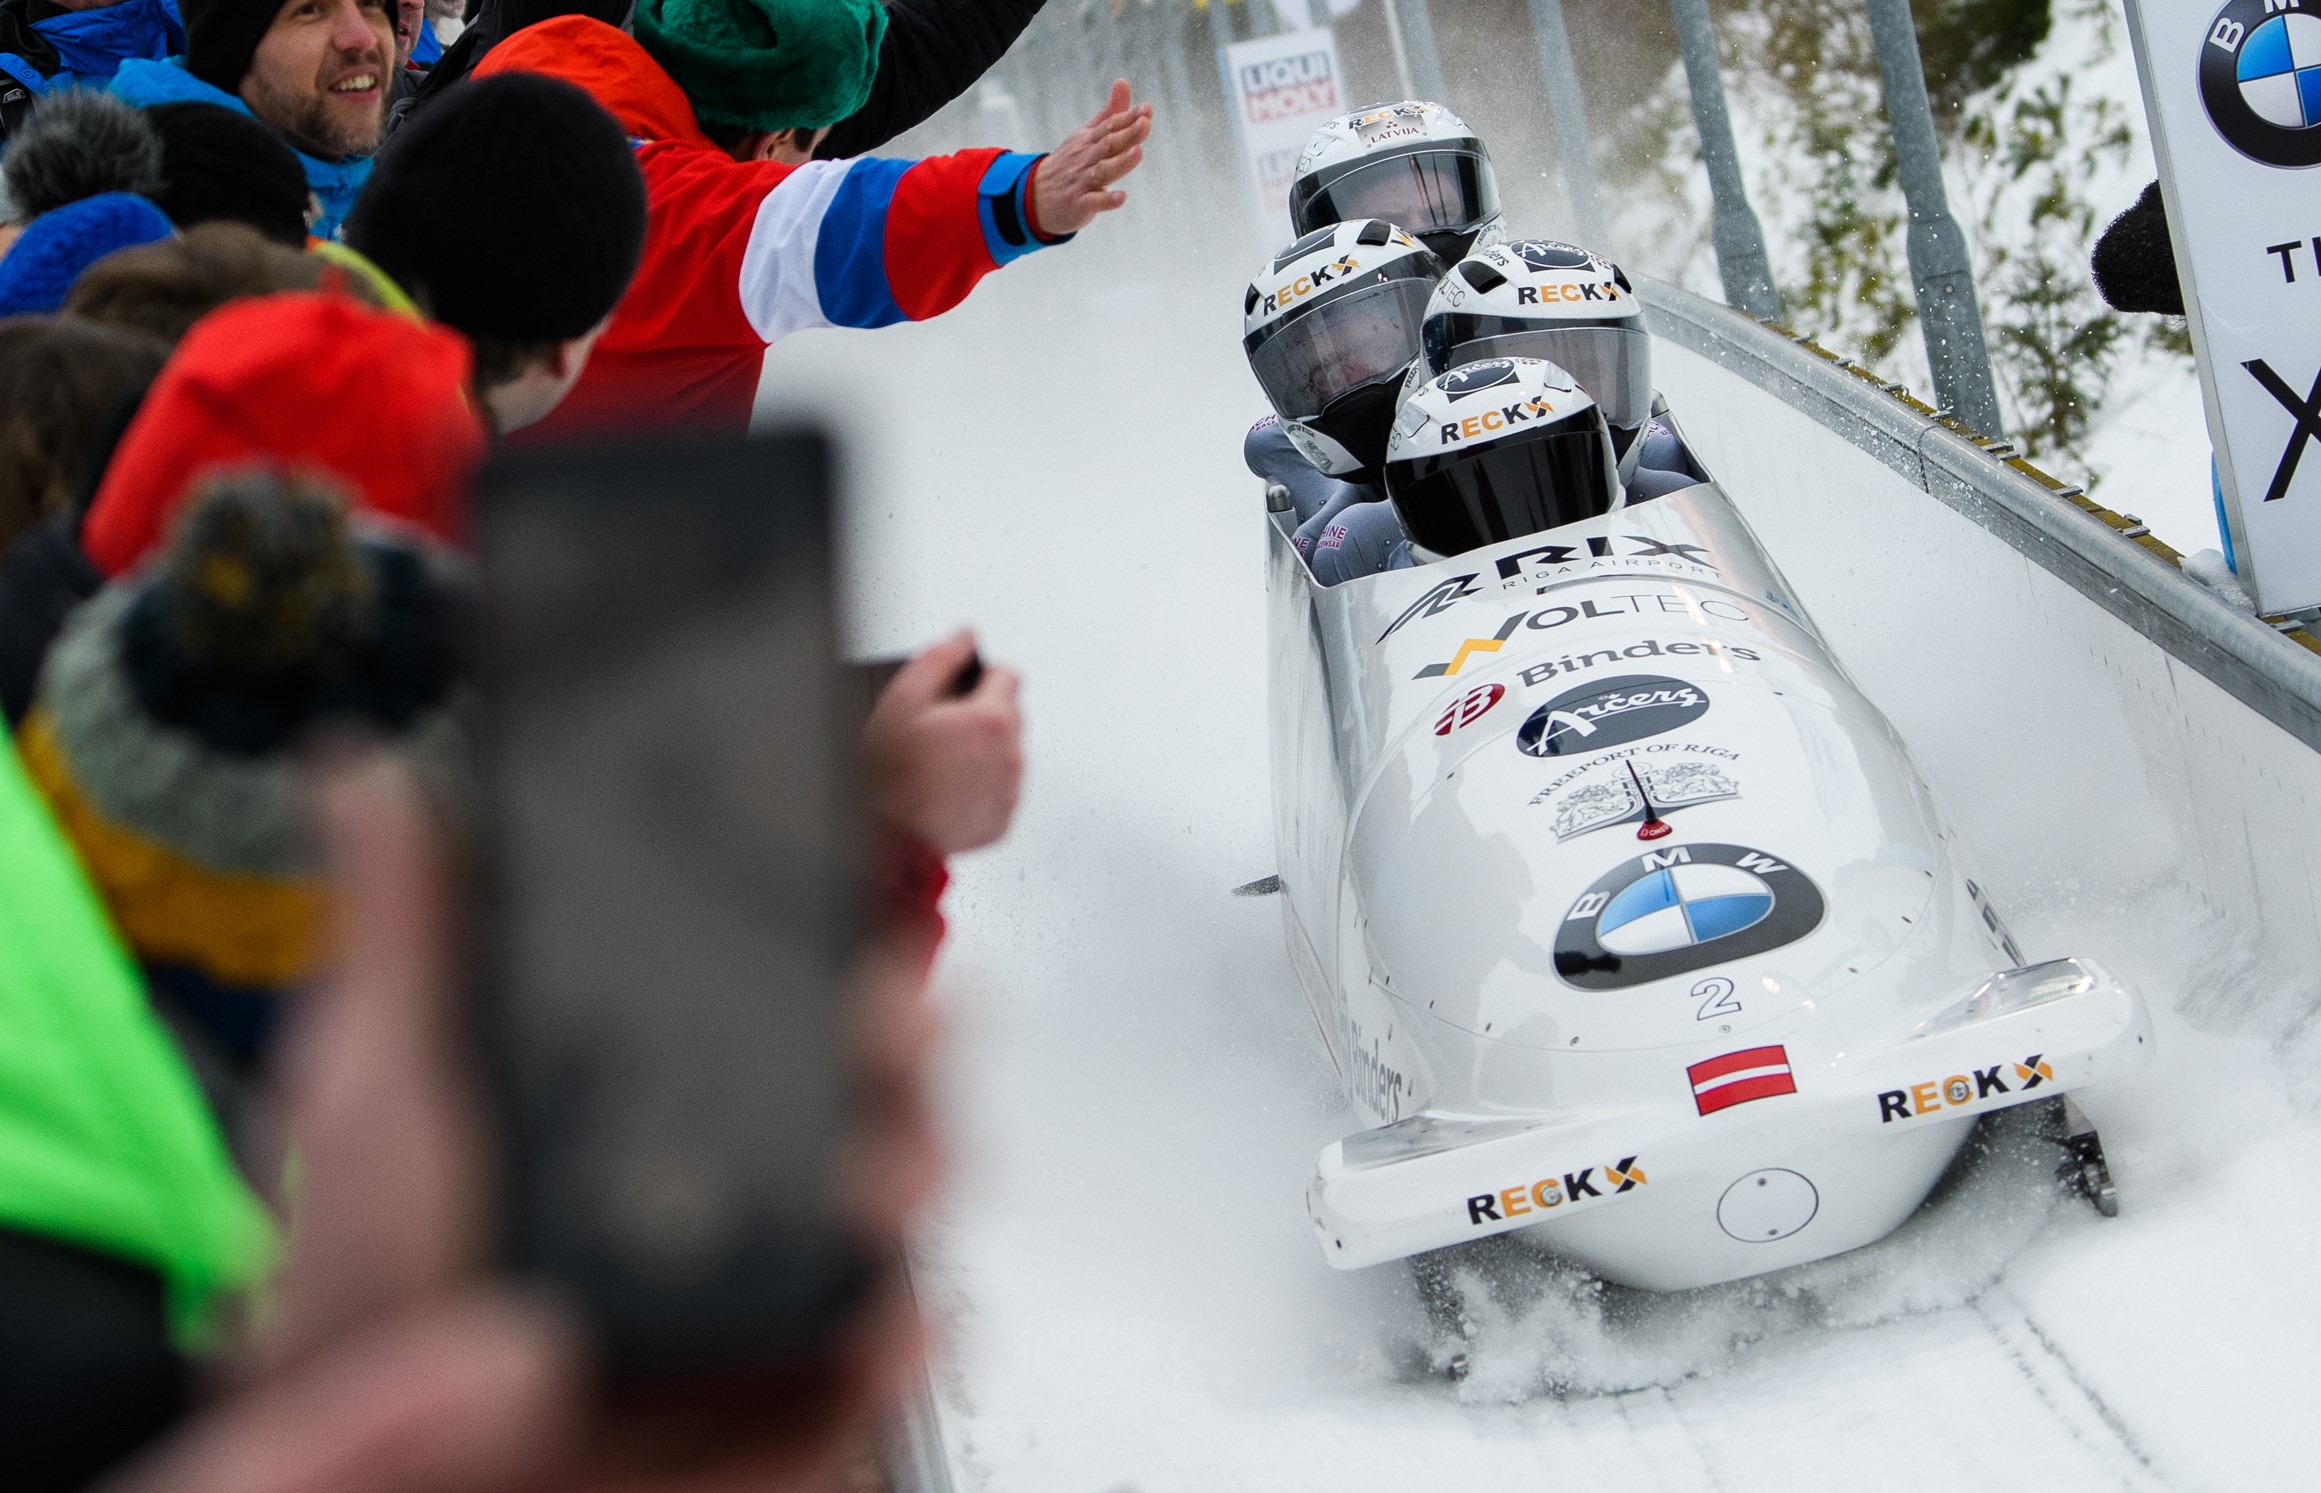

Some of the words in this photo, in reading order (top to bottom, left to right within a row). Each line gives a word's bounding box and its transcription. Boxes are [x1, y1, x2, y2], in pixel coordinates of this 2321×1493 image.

[1240, 50, 1331, 95] LIQUI
[1245, 78, 1337, 123] MOLY
[1371, 127, 1420, 144] LATVIJA
[1495, 536, 1719, 580] RIX
[1503, 566, 1572, 590] RIGA
[1590, 559, 1722, 579] AIRPORT
[1517, 640, 1761, 688] Binders
[1528, 747, 1640, 807] FREEPORT
[1646, 743, 1679, 753] OF
[1681, 743, 1741, 761] RIGA
[1567, 846, 1788, 921] BMW
[1690, 976, 1742, 1021] 2
